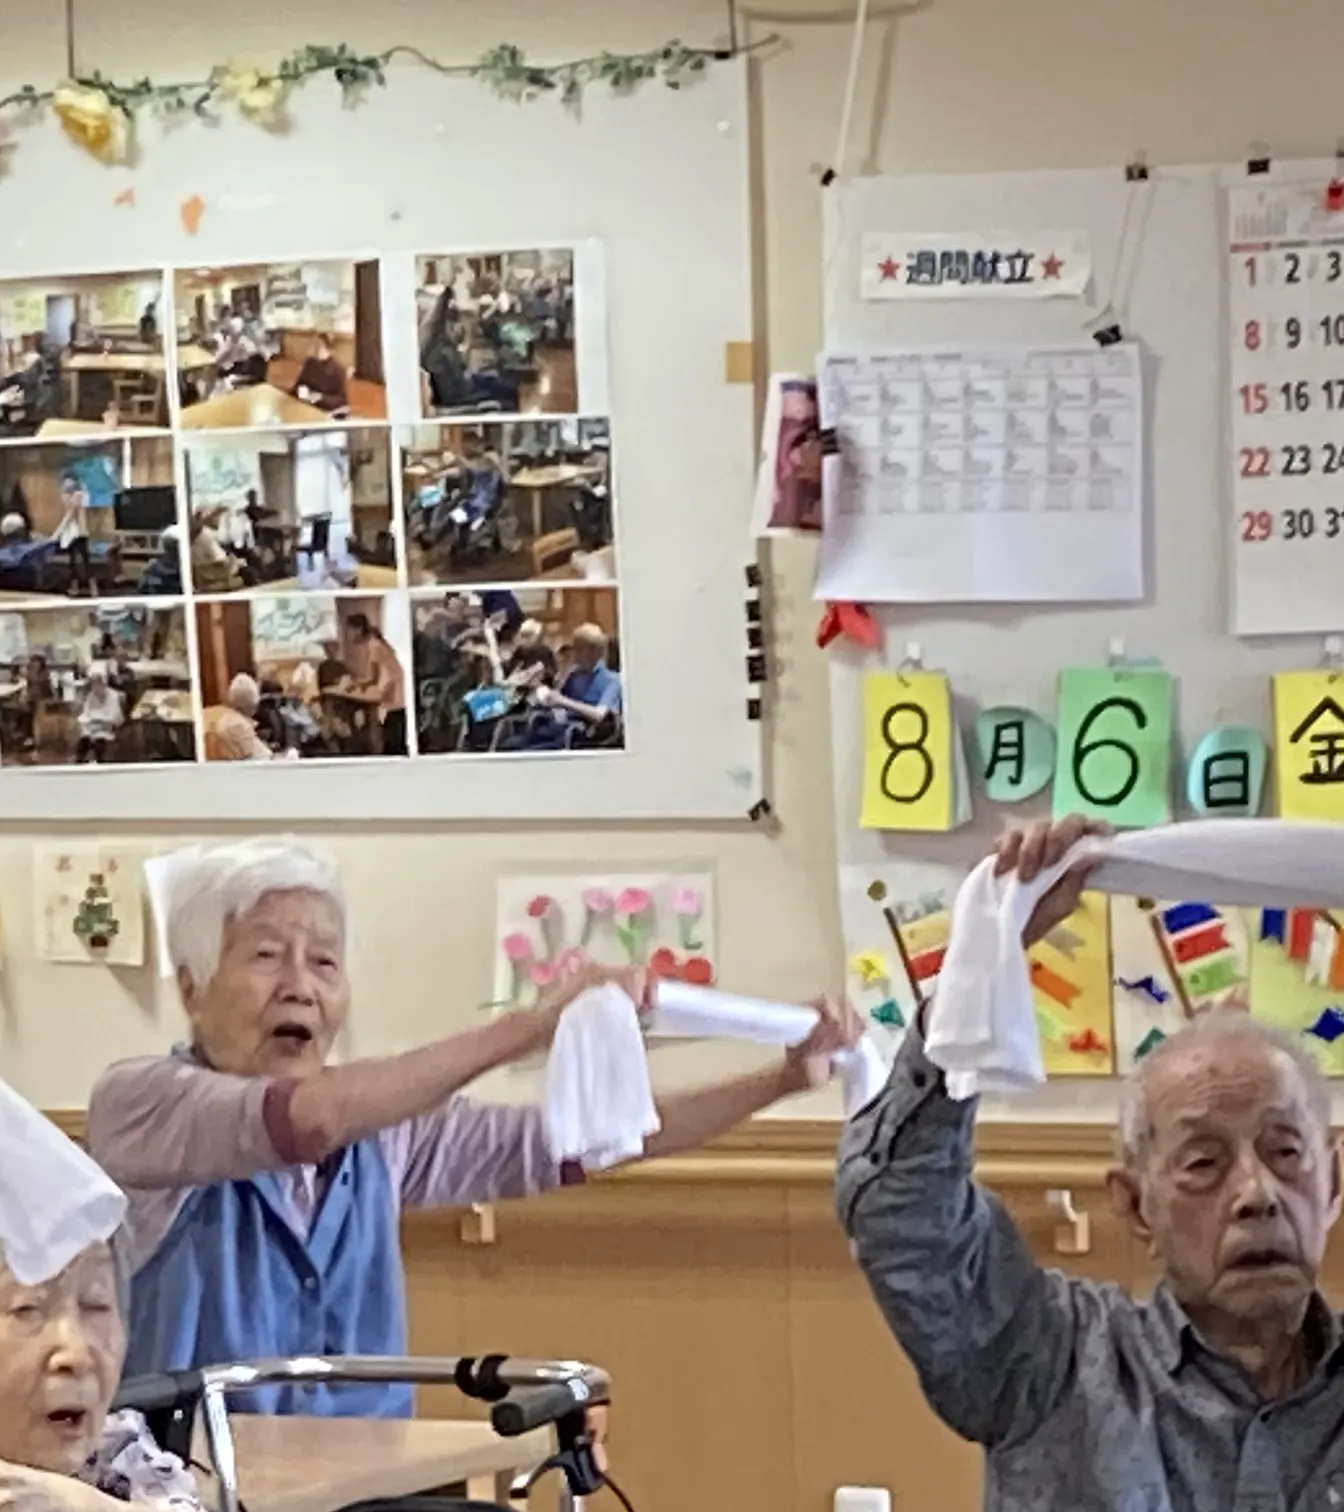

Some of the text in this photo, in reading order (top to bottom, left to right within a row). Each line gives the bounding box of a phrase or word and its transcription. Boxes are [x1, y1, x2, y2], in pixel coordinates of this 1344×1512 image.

[906, 248, 1035, 285] 週間献立
[1245, 256, 1256, 287] 1
[1284, 253, 1301, 284] 2
[1326, 251, 1342, 282] 3
[1244, 320, 1261, 351] 8
[1285, 317, 1301, 349] 9
[1239, 383, 1268, 415] 15
[1281, 381, 1309, 413] 16
[1240, 446, 1270, 478] 22
[1281, 445, 1312, 476] 23
[1241, 510, 1273, 543] 29
[1282, 508, 1315, 540] 30
[880, 702, 934, 804] 8
[984, 720, 1026, 787] 月
[1072, 696, 1147, 806] 6
[1203, 750, 1250, 808] 日
